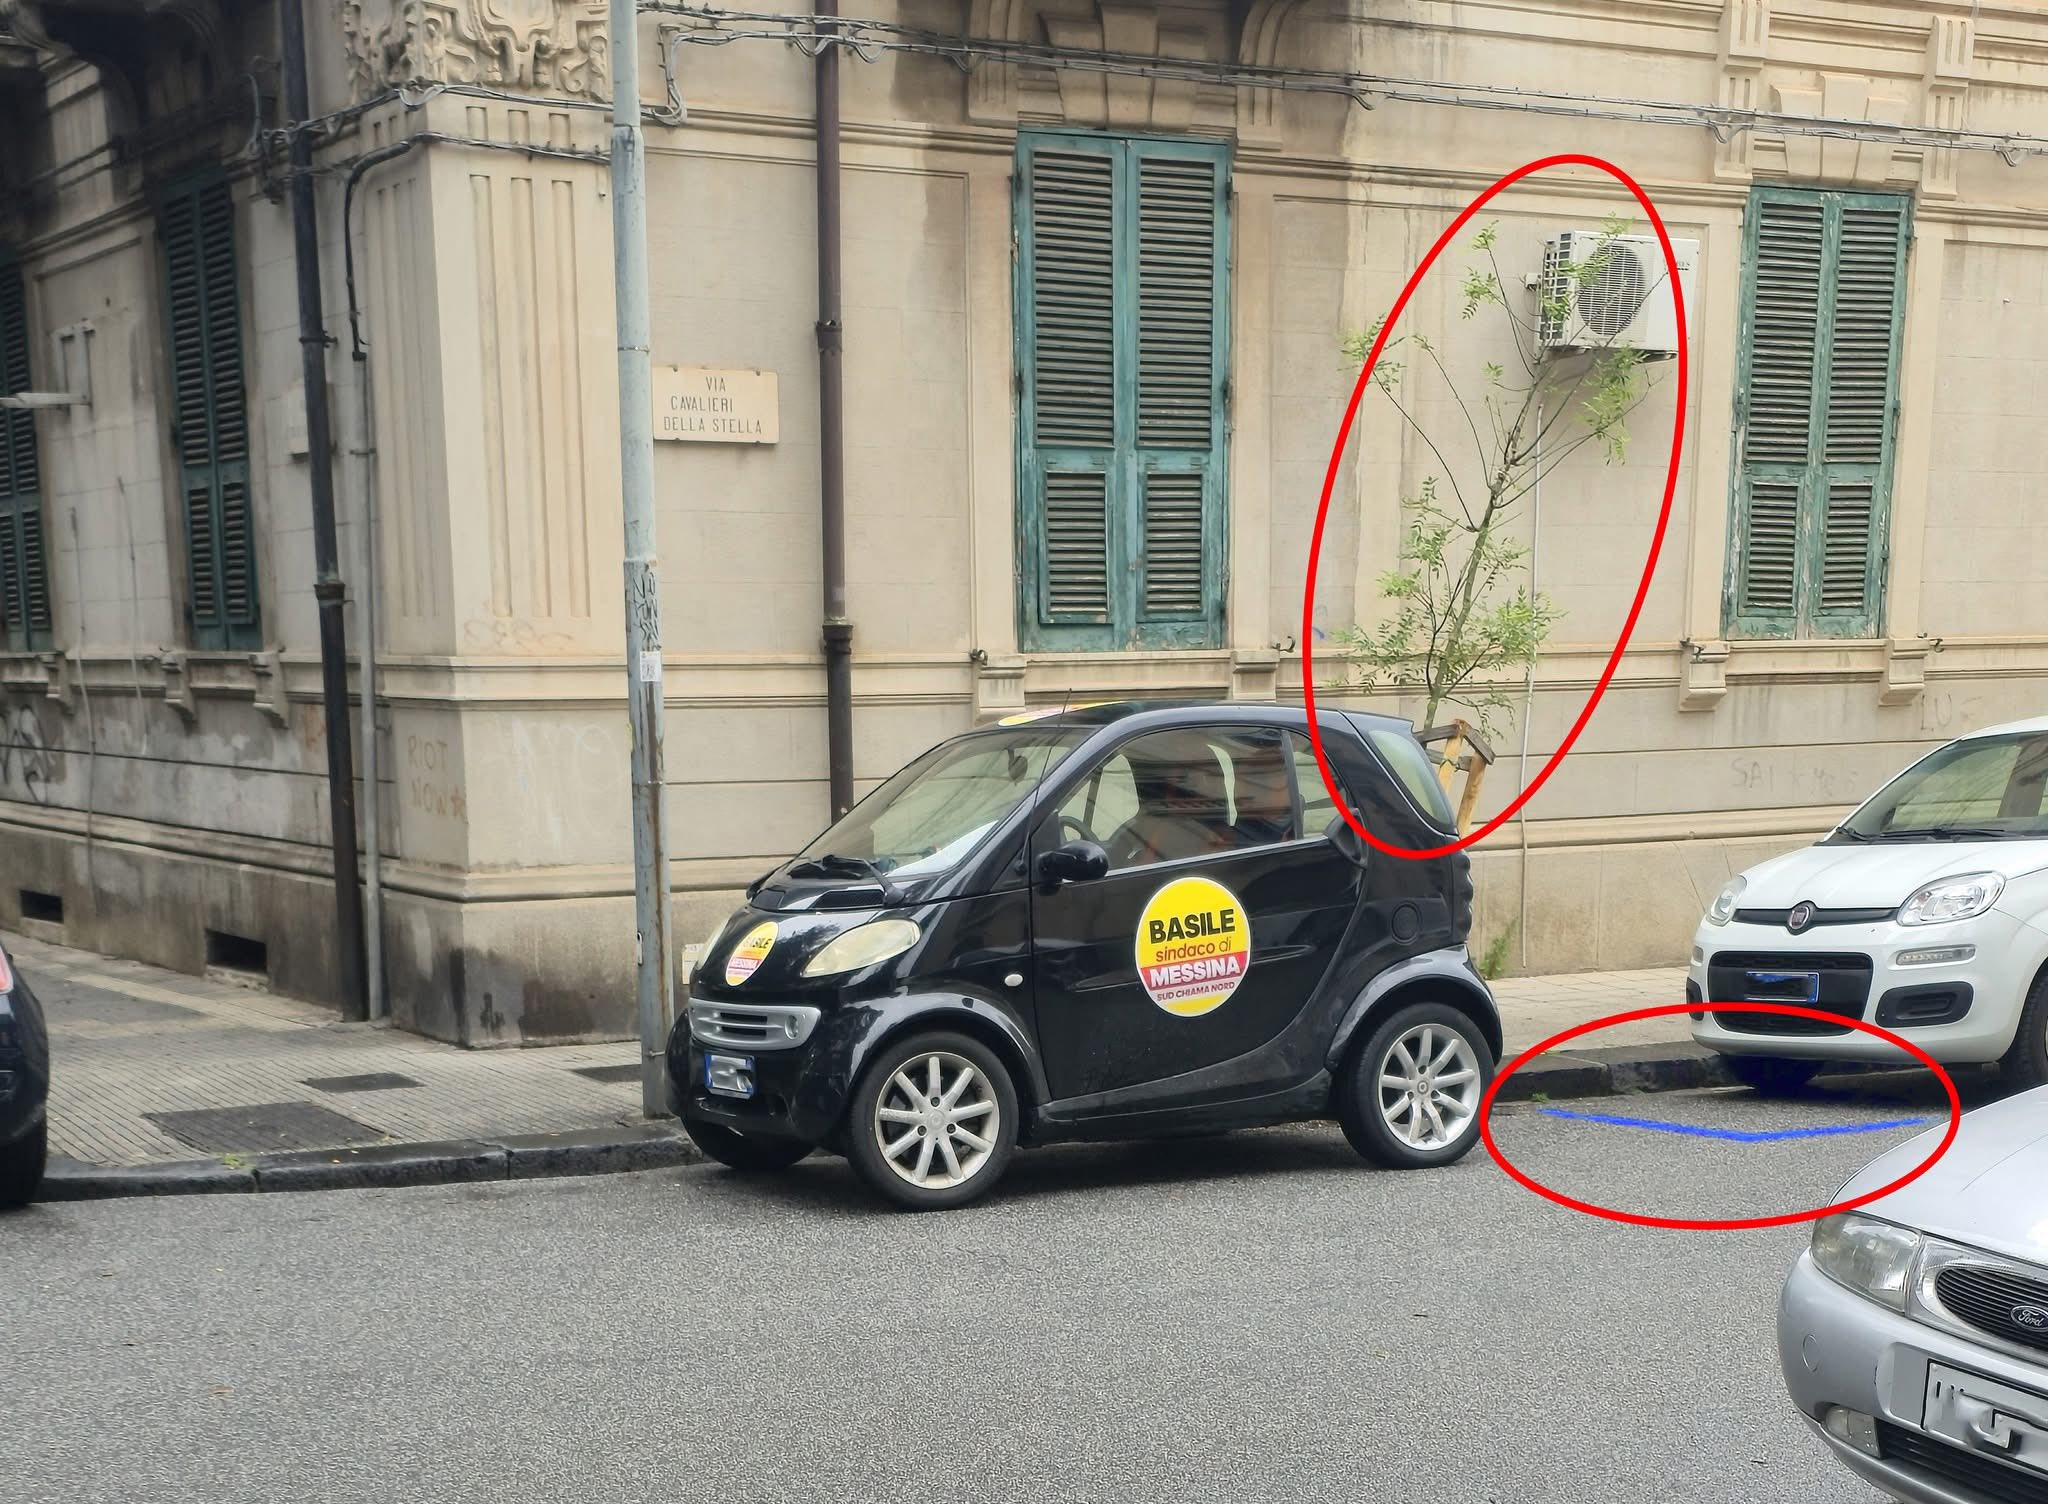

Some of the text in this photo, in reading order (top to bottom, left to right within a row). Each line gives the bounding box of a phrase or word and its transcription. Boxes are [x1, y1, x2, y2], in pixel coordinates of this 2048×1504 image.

[705, 376, 726, 392] VIA
[670, 395, 734, 413] CAVALIERI
[663, 416, 762, 434] DELLA STELLA
[1150, 909, 1235, 944] BASILE
[1156, 936, 1232, 962] sindaco di
[1151, 957, 1240, 987] MESSINA
[1157, 982, 1235, 1001] SUD CHIAMA NORD
[2017, 1309, 2045, 1327] Ford
